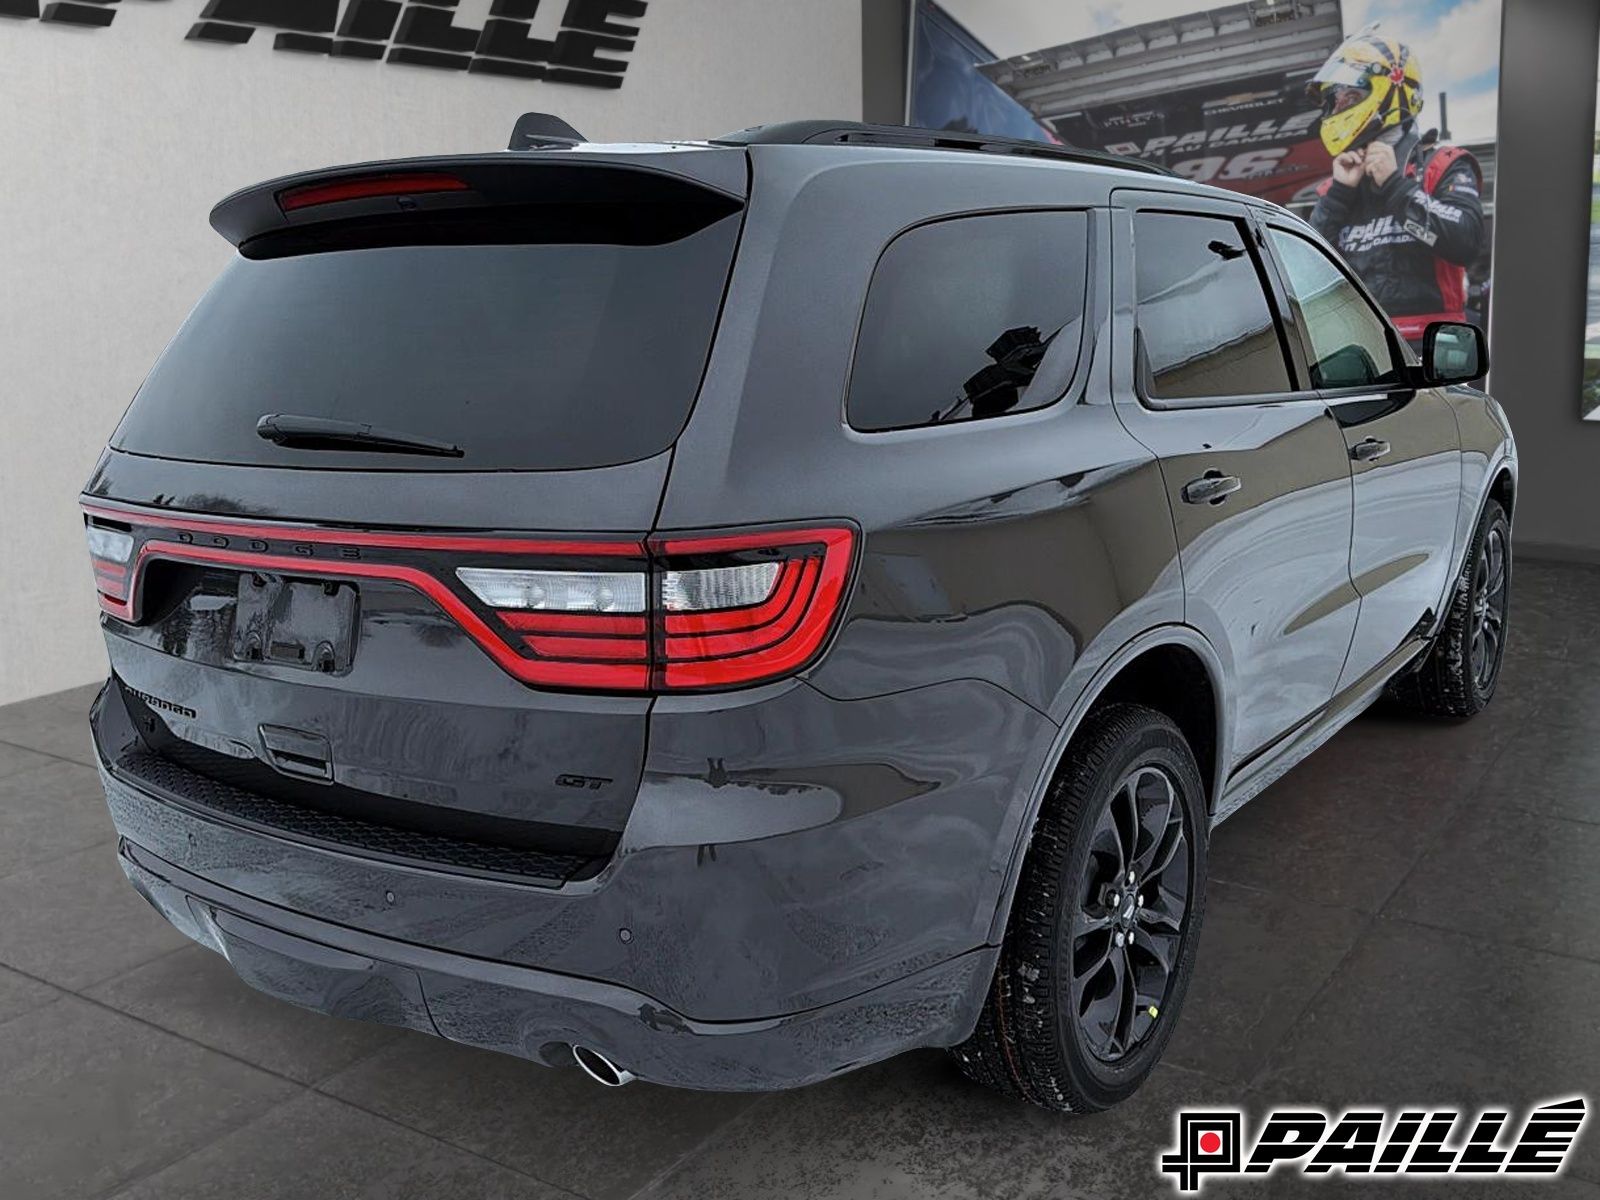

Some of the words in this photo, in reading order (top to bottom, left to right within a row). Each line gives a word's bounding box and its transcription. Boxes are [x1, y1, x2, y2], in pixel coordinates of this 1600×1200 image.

[1203, 98, 1284, 116] CHEVROLET
[1209, 129, 1308, 148] CANADA
[1172, 148, 1289, 182] 96
[178, 532, 362, 561] DODGE
[554, 773, 614, 790] GT
